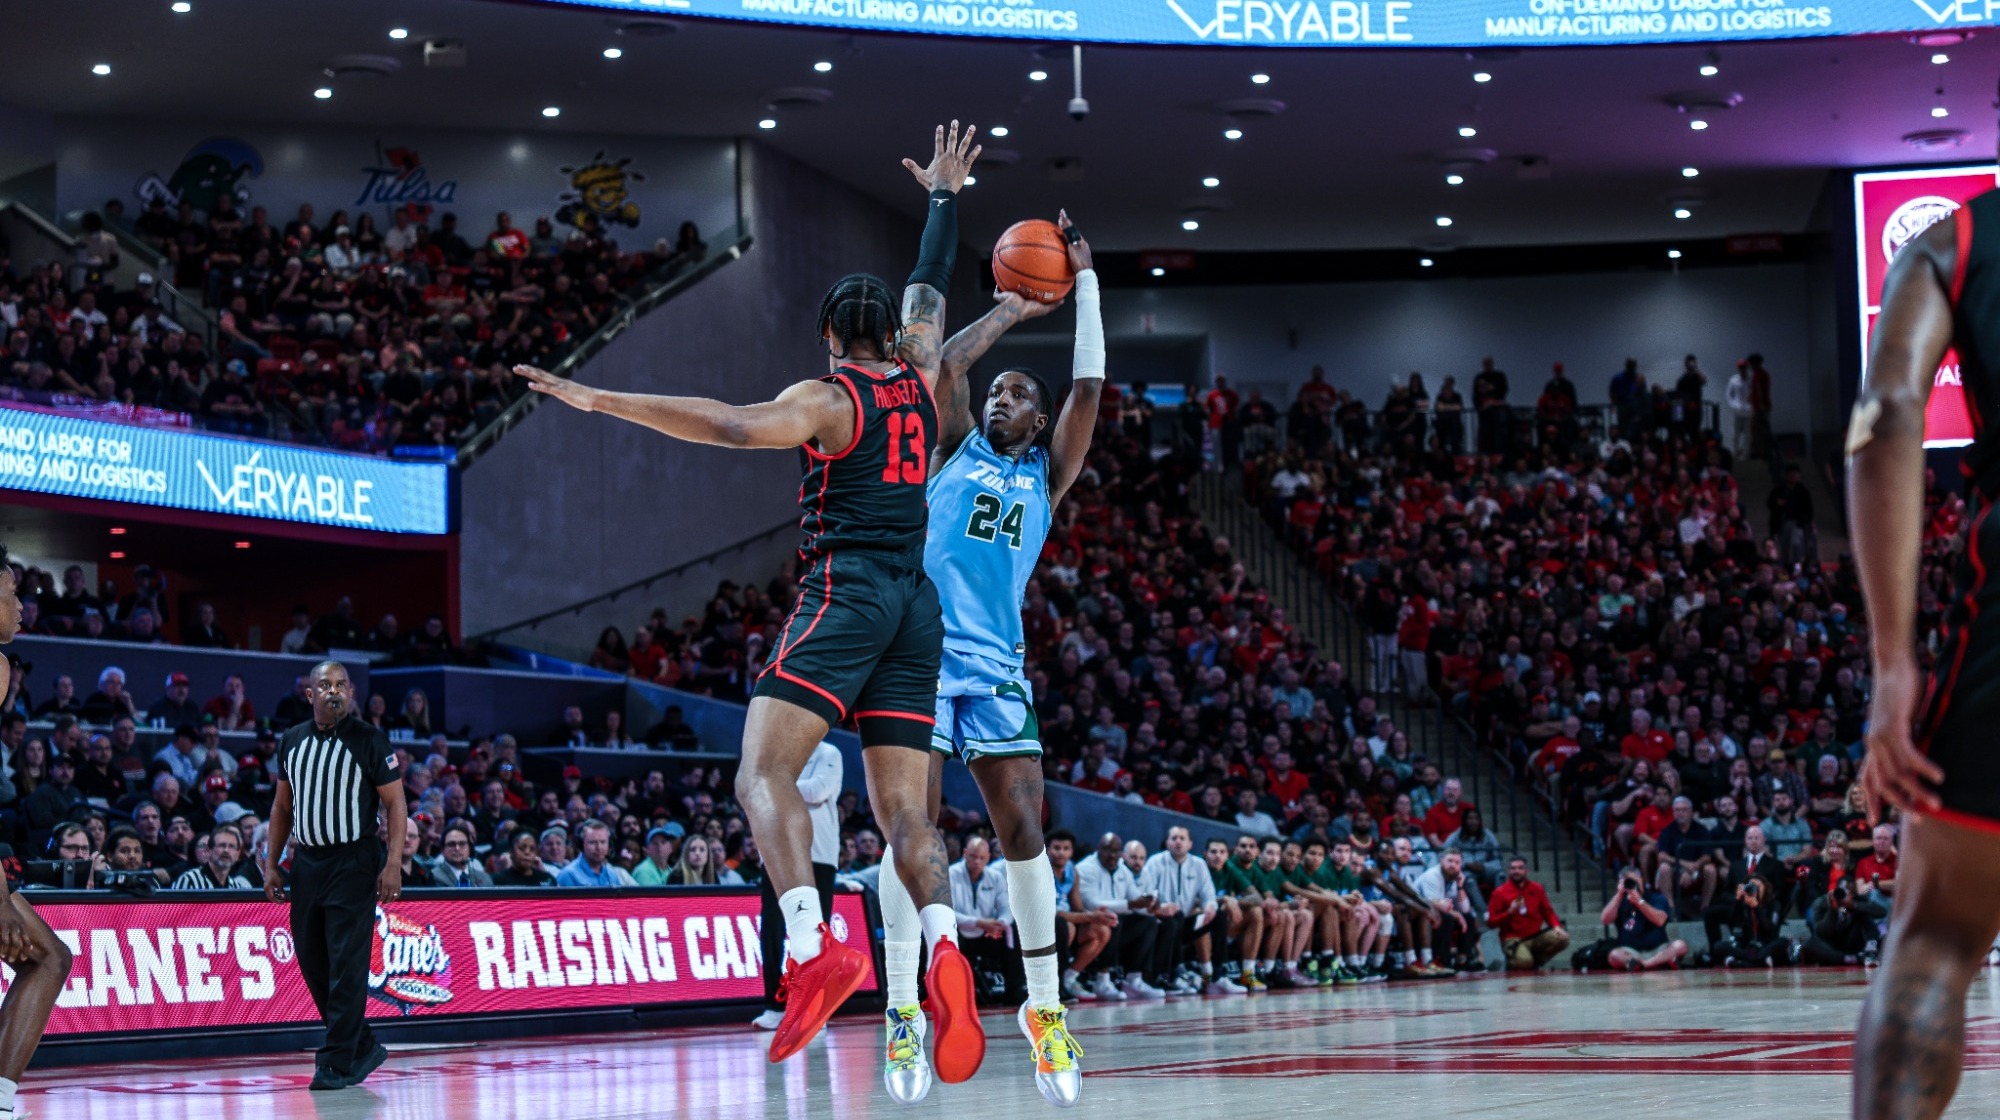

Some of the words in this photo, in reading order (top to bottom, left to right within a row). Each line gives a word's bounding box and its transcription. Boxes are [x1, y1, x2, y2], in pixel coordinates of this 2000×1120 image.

[922, 4, 969, 26] AND
[972, 6, 1078, 31] LOGISTICS
[1485, 12, 1667, 37] MANUFACTURING
[1671, 11, 1718, 33] AND
[1721, 6, 1832, 31] LOGISTICS
[356, 167, 457, 206] Tulsa
[39, 430, 94, 458] LABOR
[97, 438, 131, 464] FOR
[882, 411, 926, 484] 13
[39, 456, 77, 482] AND
[81, 462, 167, 494] LOGISTICS
[965, 491, 1026, 551] 24
[469, 917, 678, 991] RAISING
